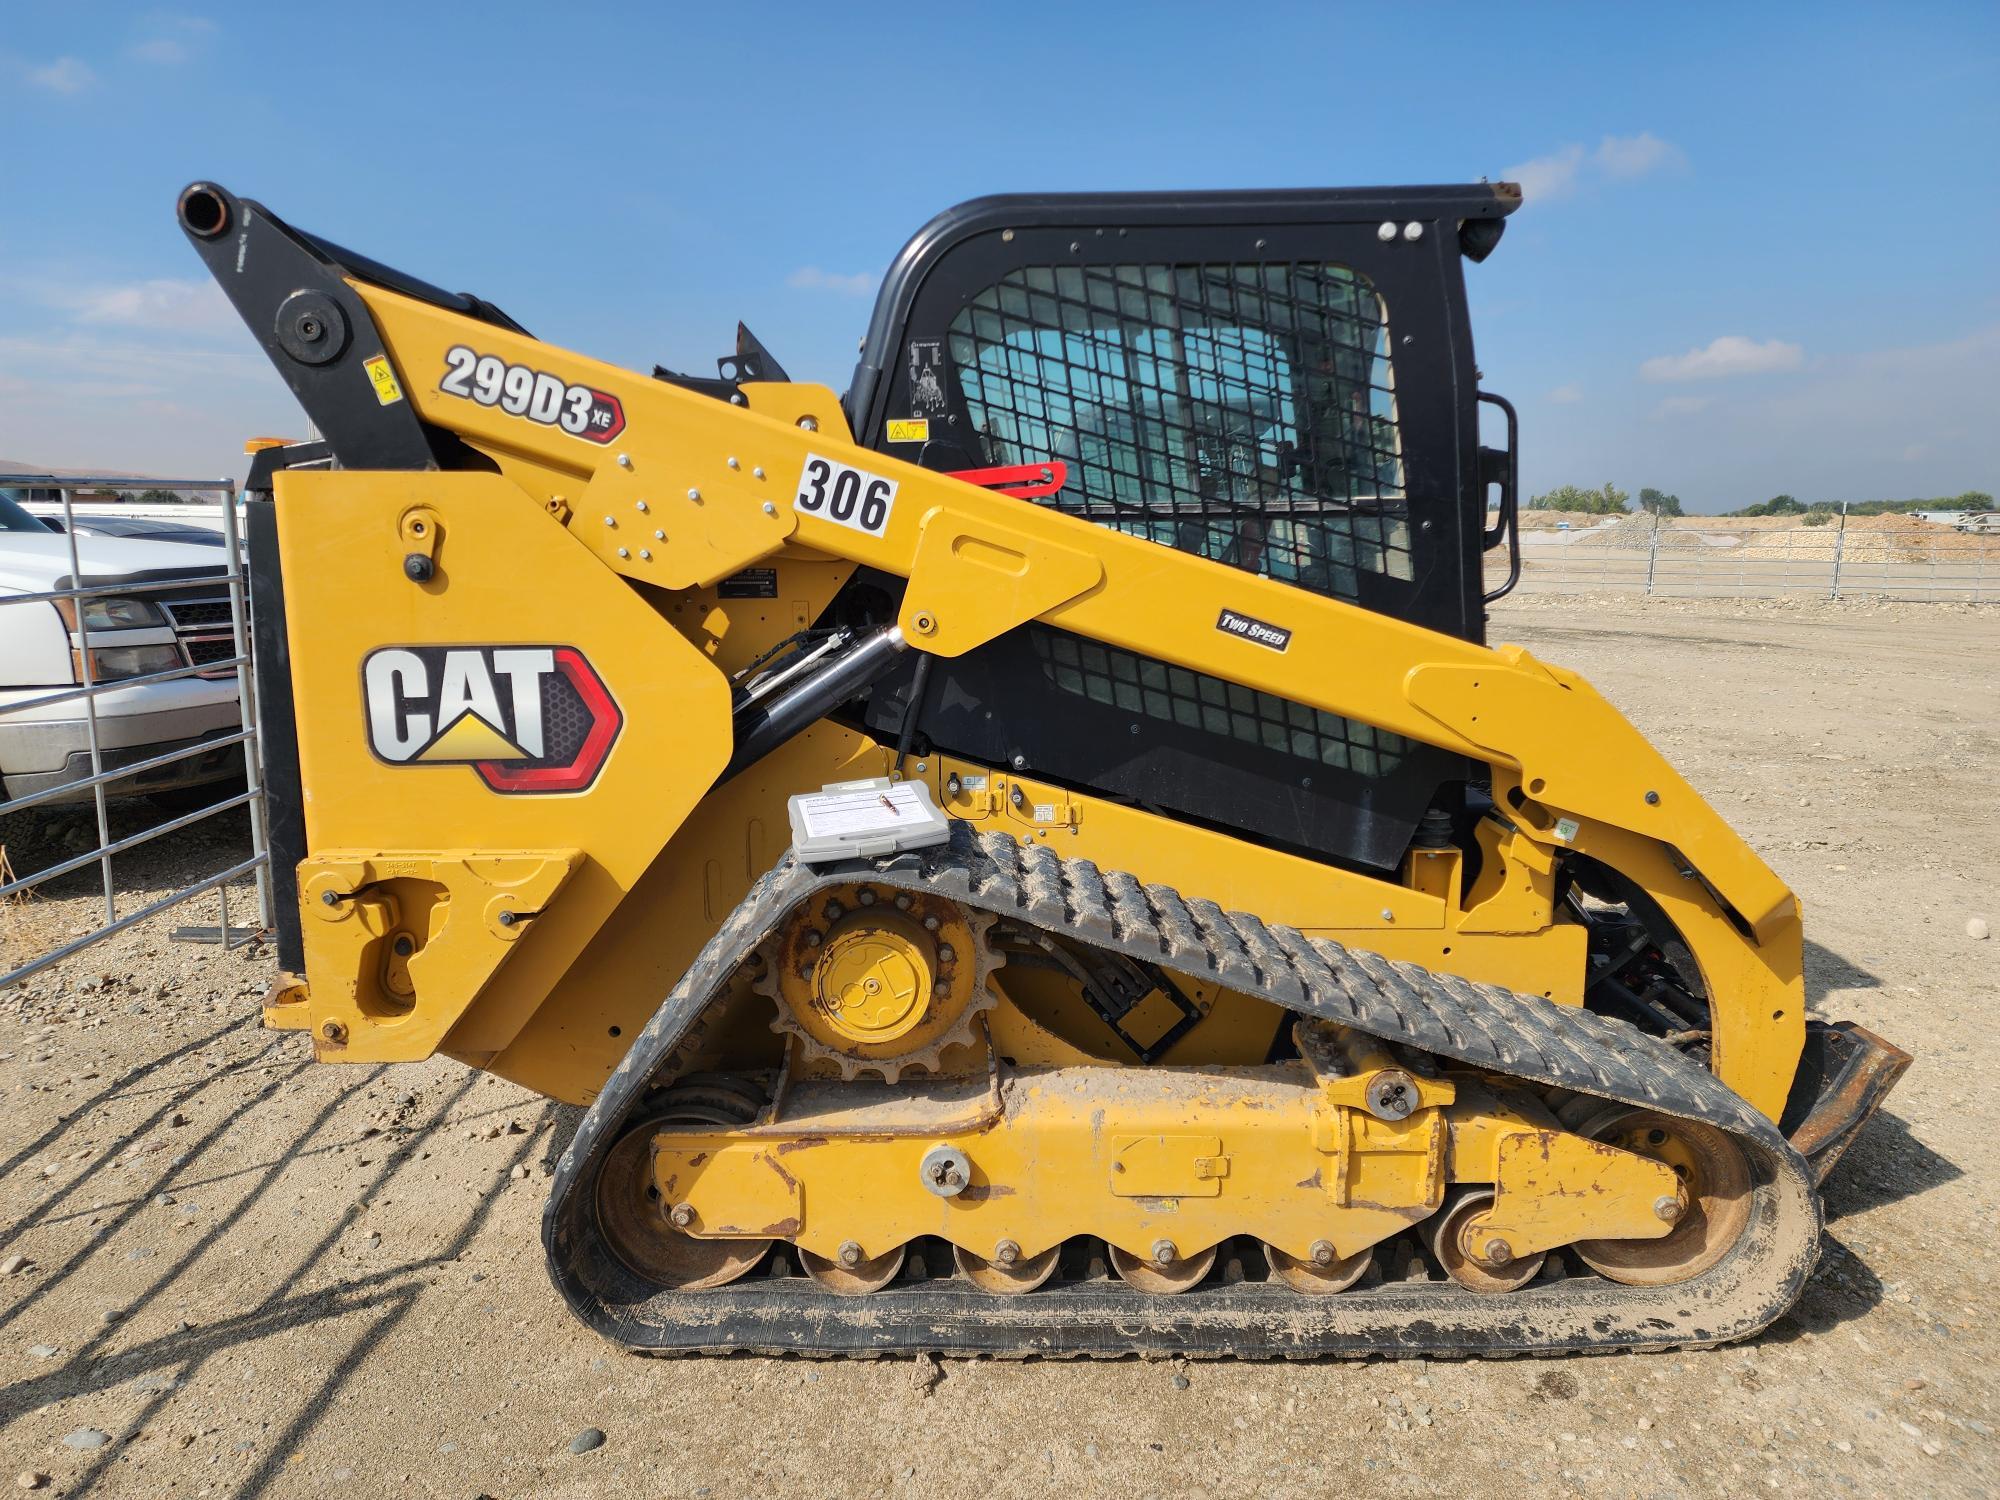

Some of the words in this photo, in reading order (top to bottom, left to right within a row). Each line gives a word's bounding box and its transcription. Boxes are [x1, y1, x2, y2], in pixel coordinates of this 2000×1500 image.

[441, 346, 594, 434] 299D3
[591, 408, 612, 429] XE
[799, 459, 891, 531] 306
[1221, 614, 1249, 633] TWO
[1247, 623, 1286, 645] SPEED
[365, 649, 555, 761] CAT
